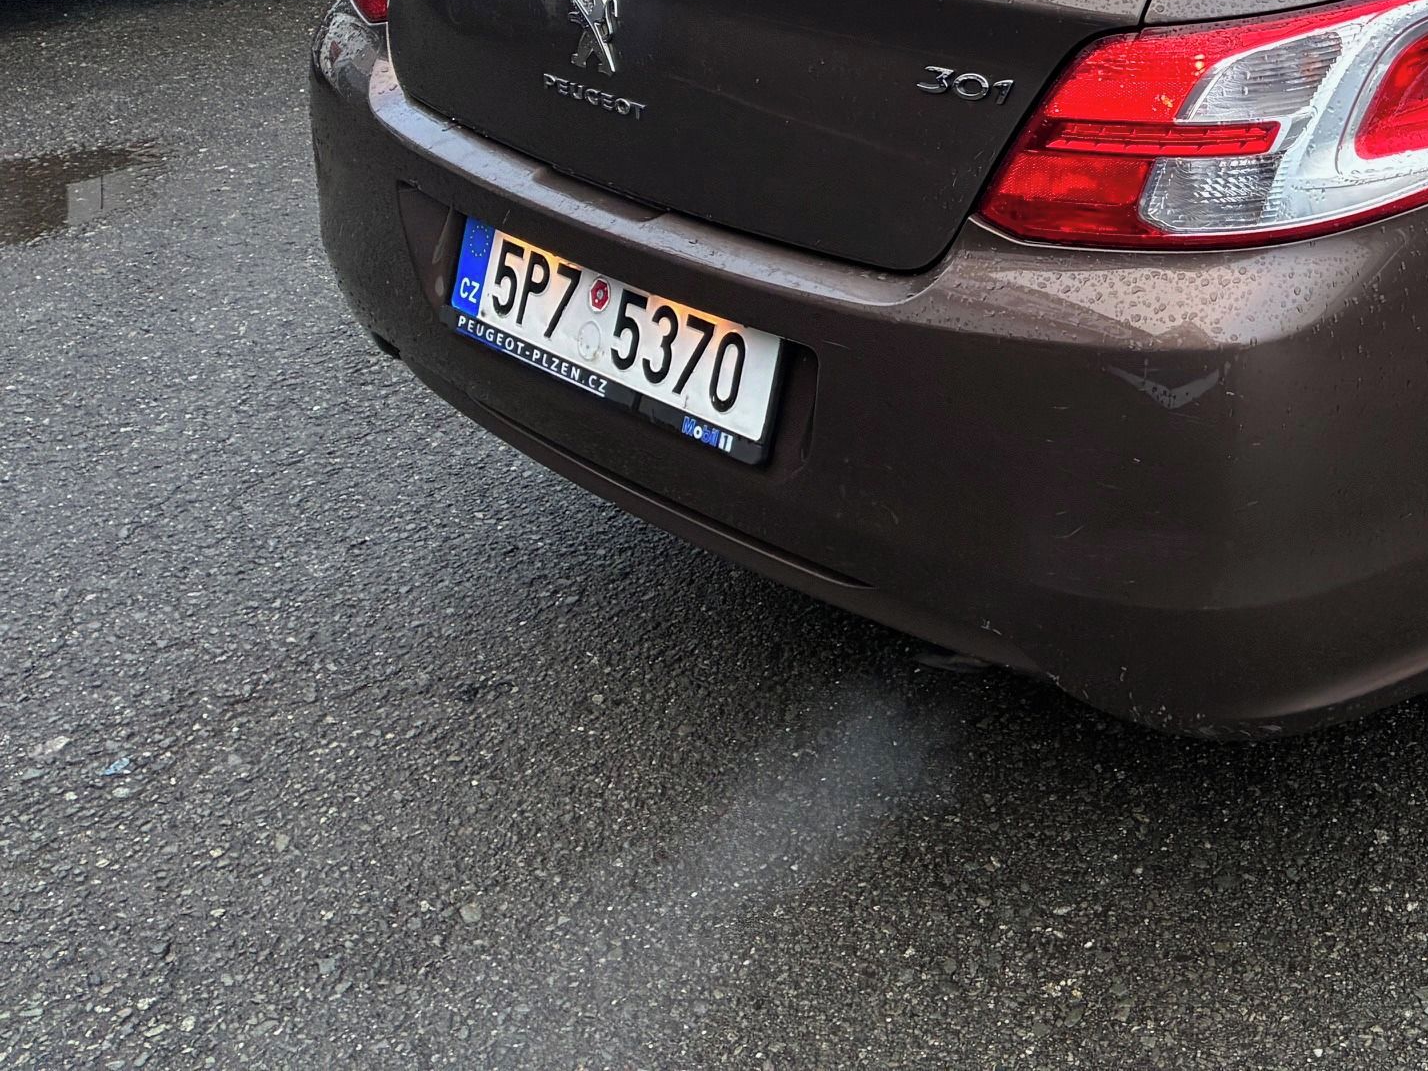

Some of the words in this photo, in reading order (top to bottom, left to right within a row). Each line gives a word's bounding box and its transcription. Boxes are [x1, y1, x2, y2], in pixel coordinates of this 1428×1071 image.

[543, 72, 647, 120] PEUGEOT
[915, 64, 1017, 106] 301
[459, 277, 480, 304] CZ
[490, 238, 582, 341] 5P7
[609, 288, 747, 414] 5370
[681, 416, 720, 448] Mobil
